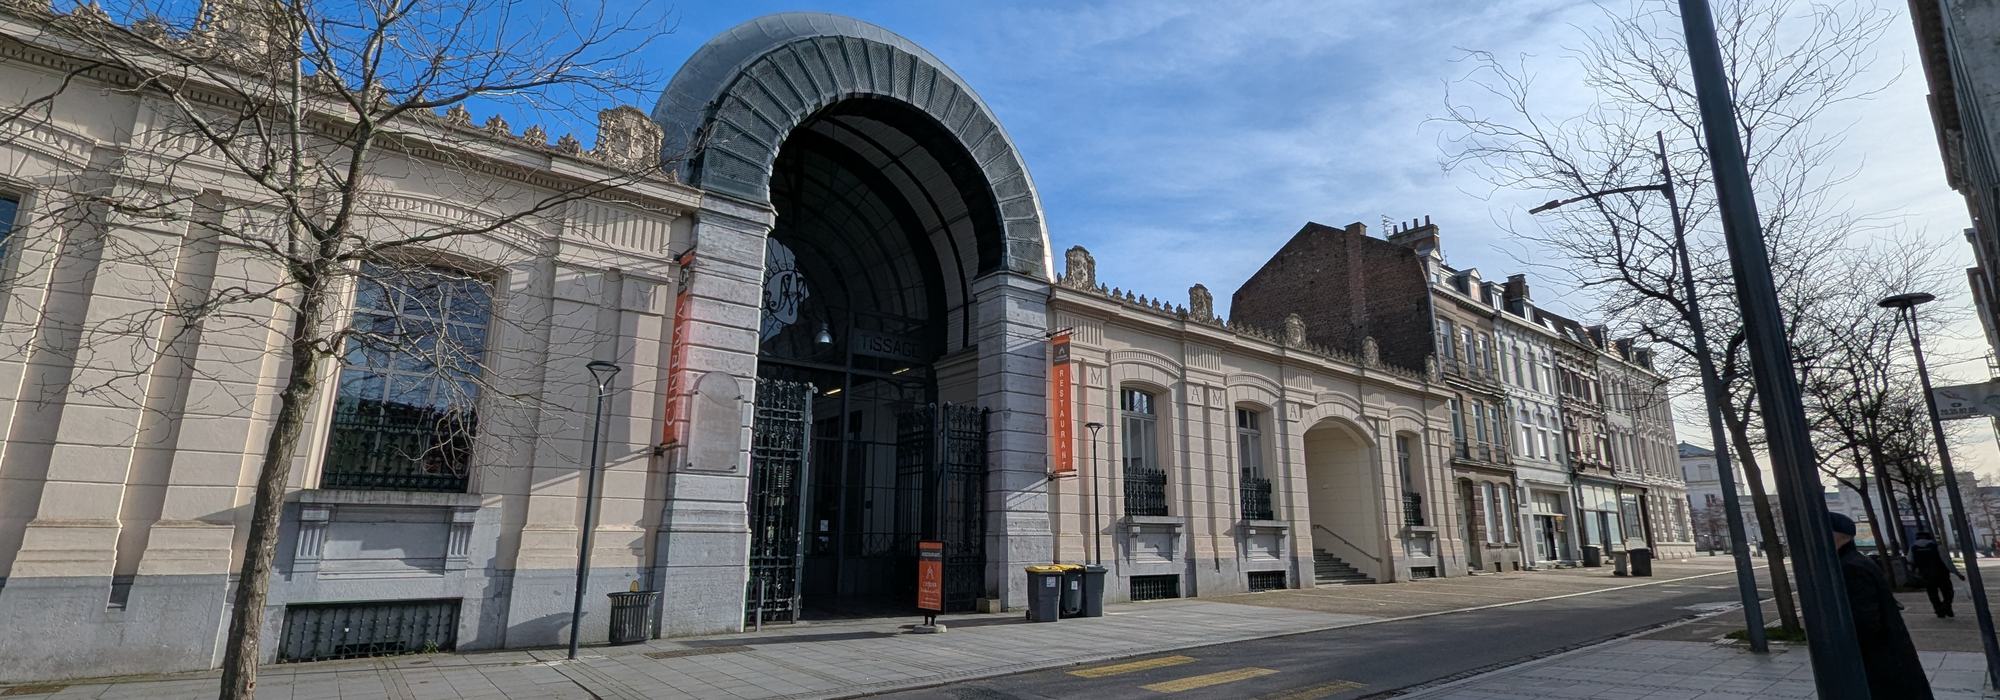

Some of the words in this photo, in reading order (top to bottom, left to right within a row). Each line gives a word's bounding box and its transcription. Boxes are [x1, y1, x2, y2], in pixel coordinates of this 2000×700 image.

[860, 334, 921, 358] TISSAGE
[1090, 367, 1103, 386] M
[1191, 385, 1201, 402] A
[1212, 389, 1223, 406] M
[1059, 369, 1067, 469] RESTAURANT
[1290, 404, 1298, 419] A
